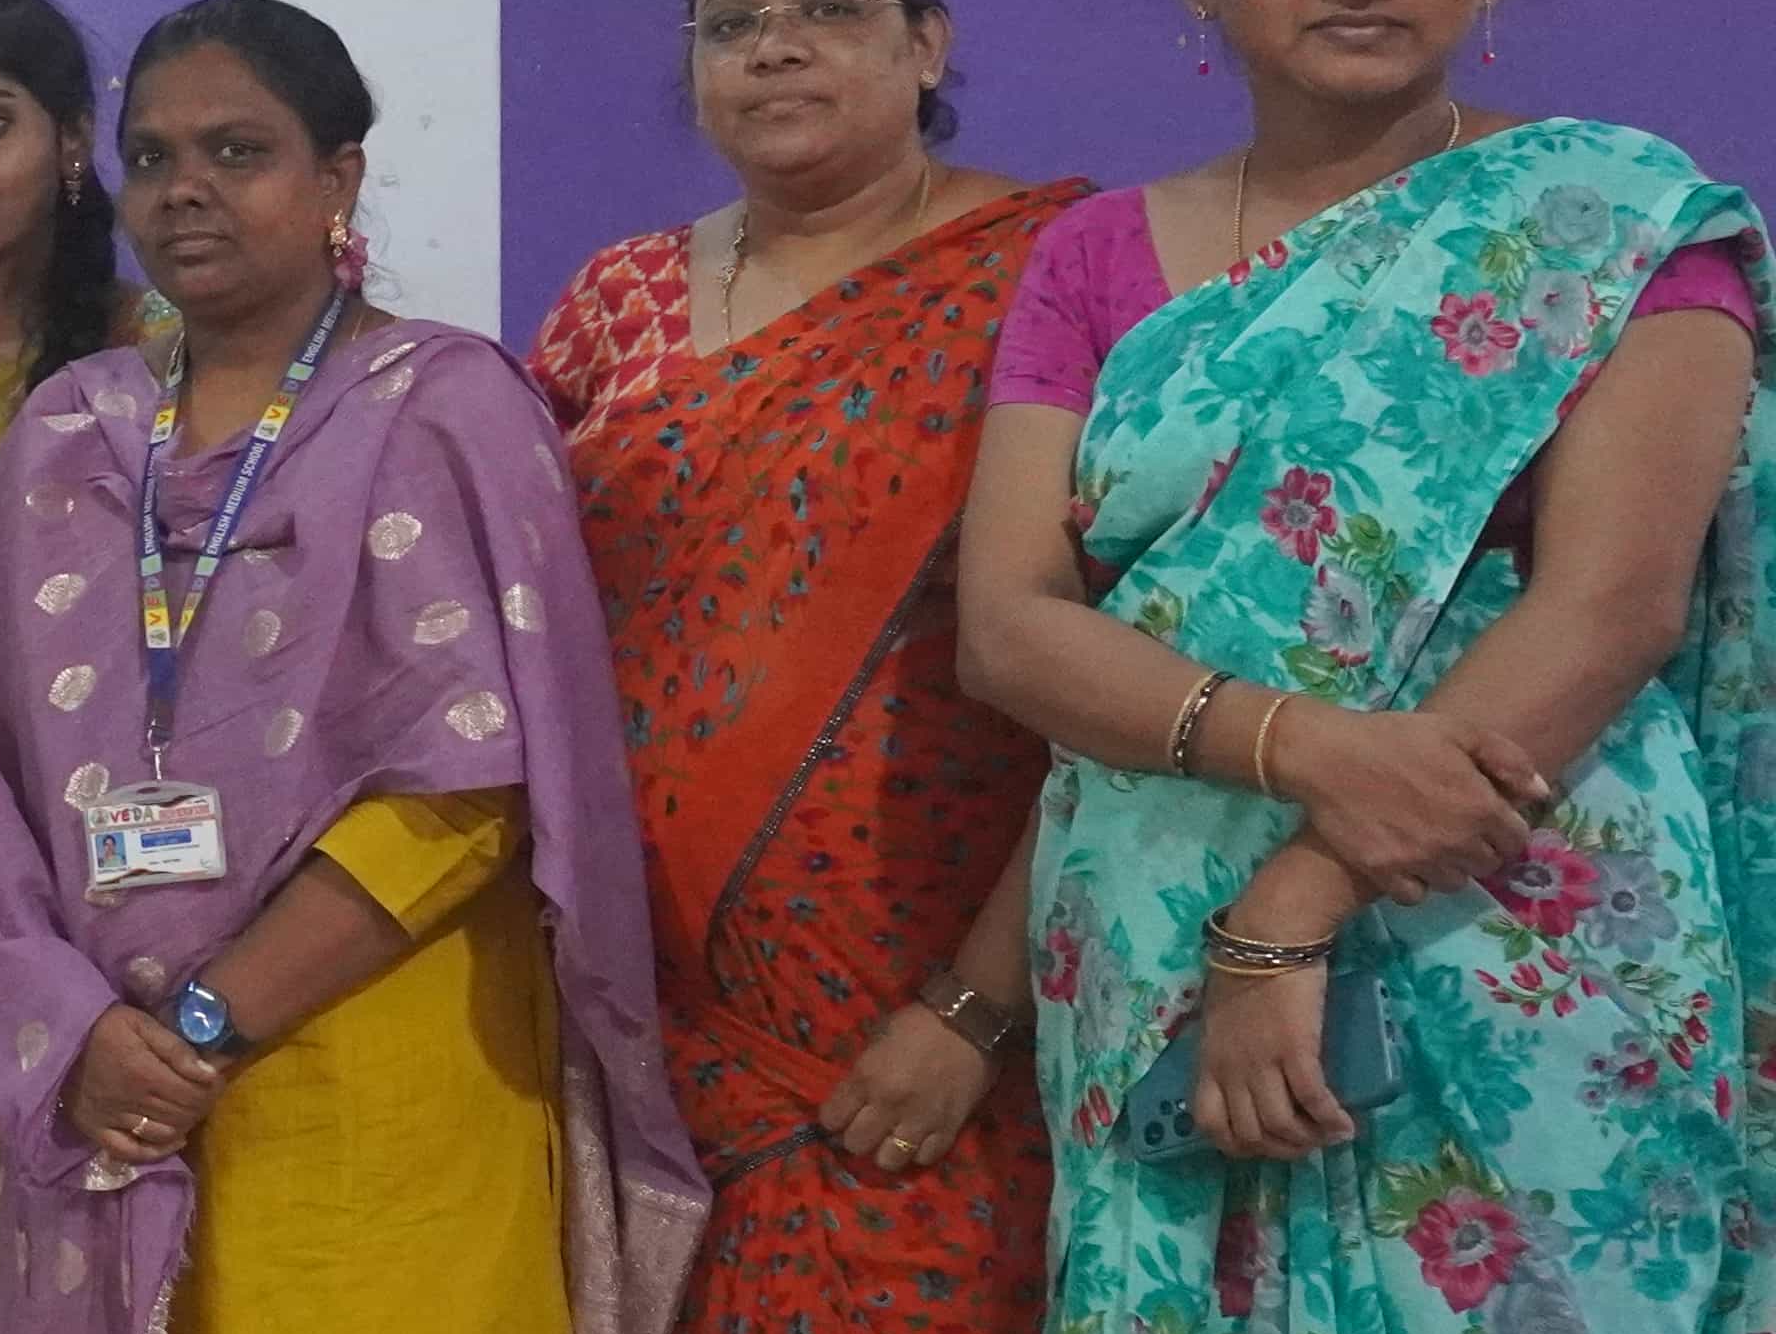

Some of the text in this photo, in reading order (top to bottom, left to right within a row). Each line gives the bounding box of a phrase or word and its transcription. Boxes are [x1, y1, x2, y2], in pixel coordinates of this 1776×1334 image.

[301, 329, 329, 363] ENGLISH
[206, 515, 233, 556] ENGLISH
[223, 476, 249, 516] MEDIUM
[240, 441, 267, 478] SCHOOL
[144, 514, 155, 555] ENGLISH
[110, 805, 154, 823] VEDA
